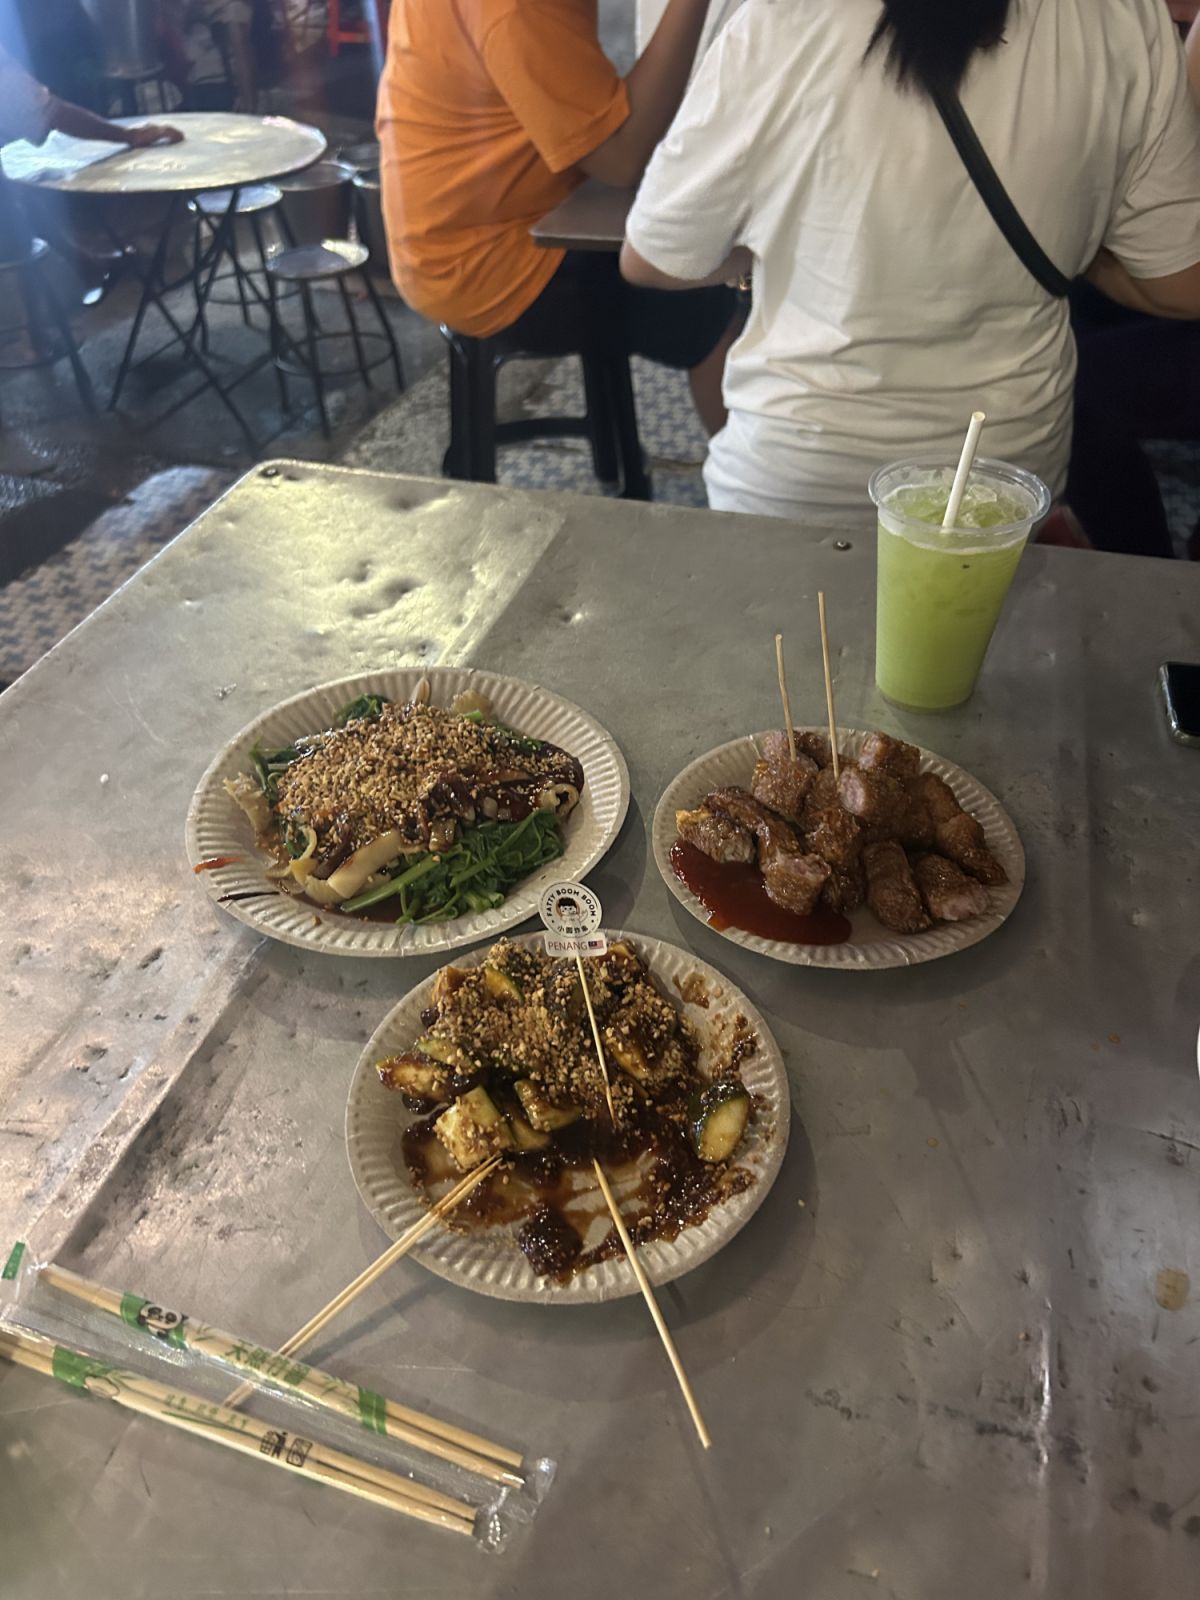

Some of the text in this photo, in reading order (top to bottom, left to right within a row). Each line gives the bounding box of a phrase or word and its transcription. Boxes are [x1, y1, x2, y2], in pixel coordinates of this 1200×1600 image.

[546, 888, 597, 917] FATTY BOOM BOOM
[548, 941, 588, 951] PENANG
